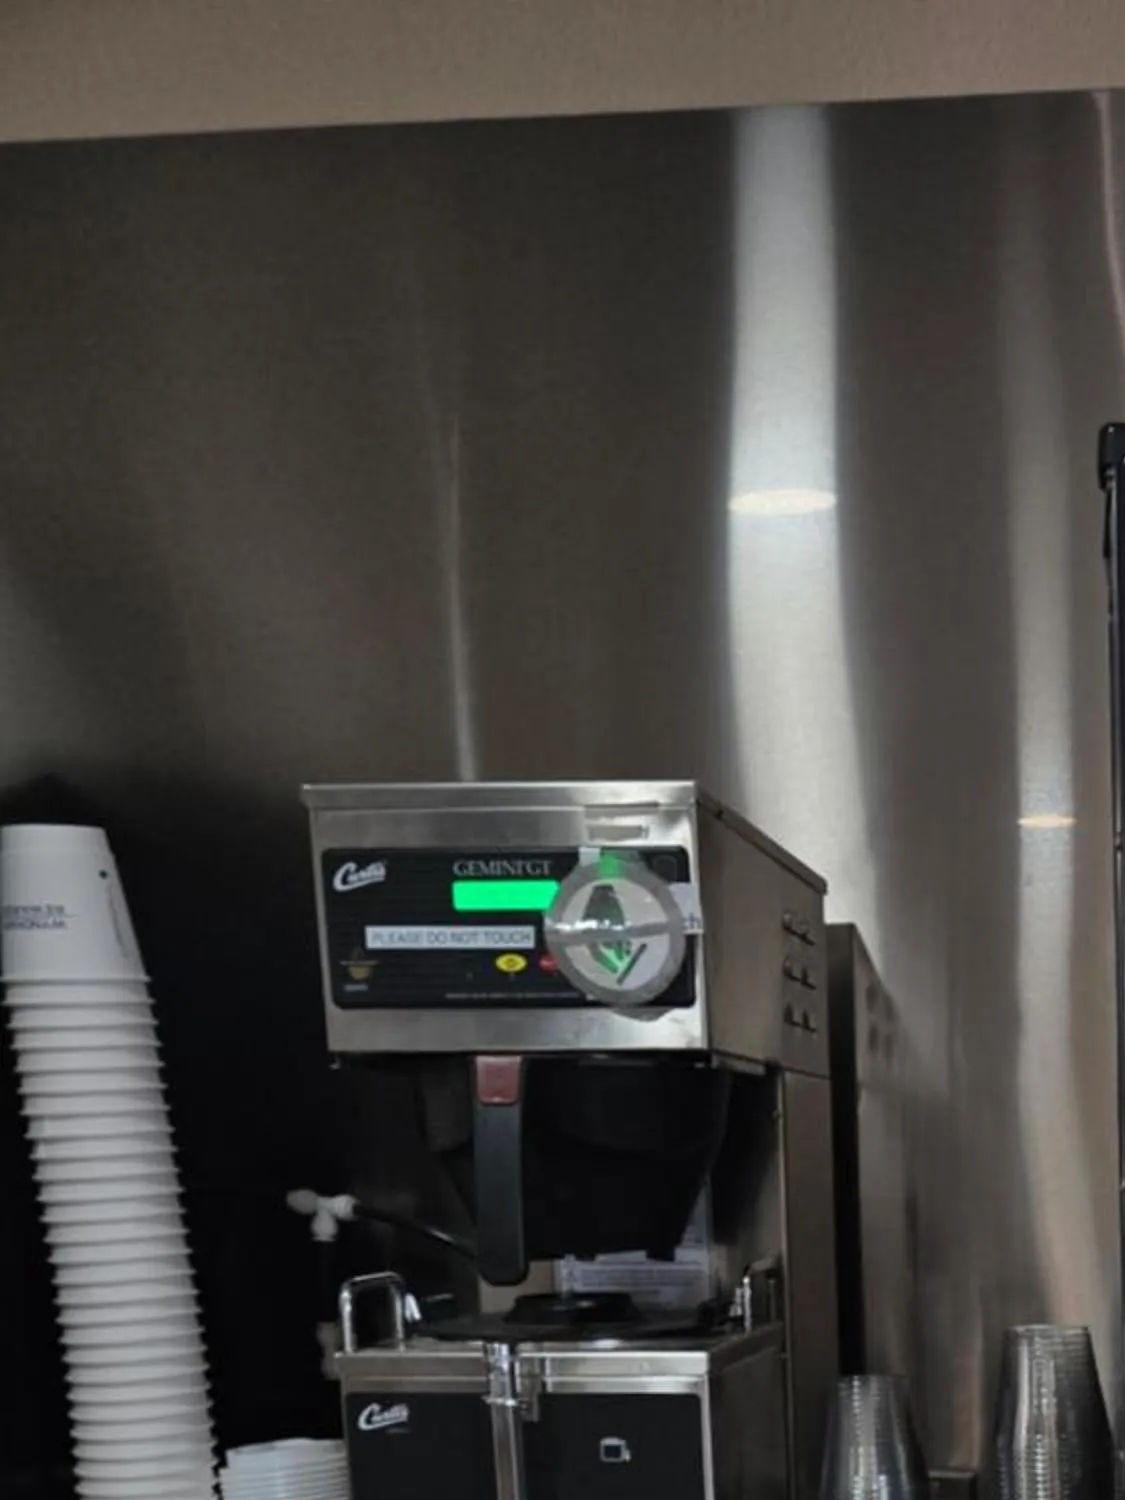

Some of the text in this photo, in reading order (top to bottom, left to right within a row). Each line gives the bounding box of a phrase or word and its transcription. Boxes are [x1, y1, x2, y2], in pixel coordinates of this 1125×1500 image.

[371, 930, 533, 945] PLEASE DO NOT TOUCH
